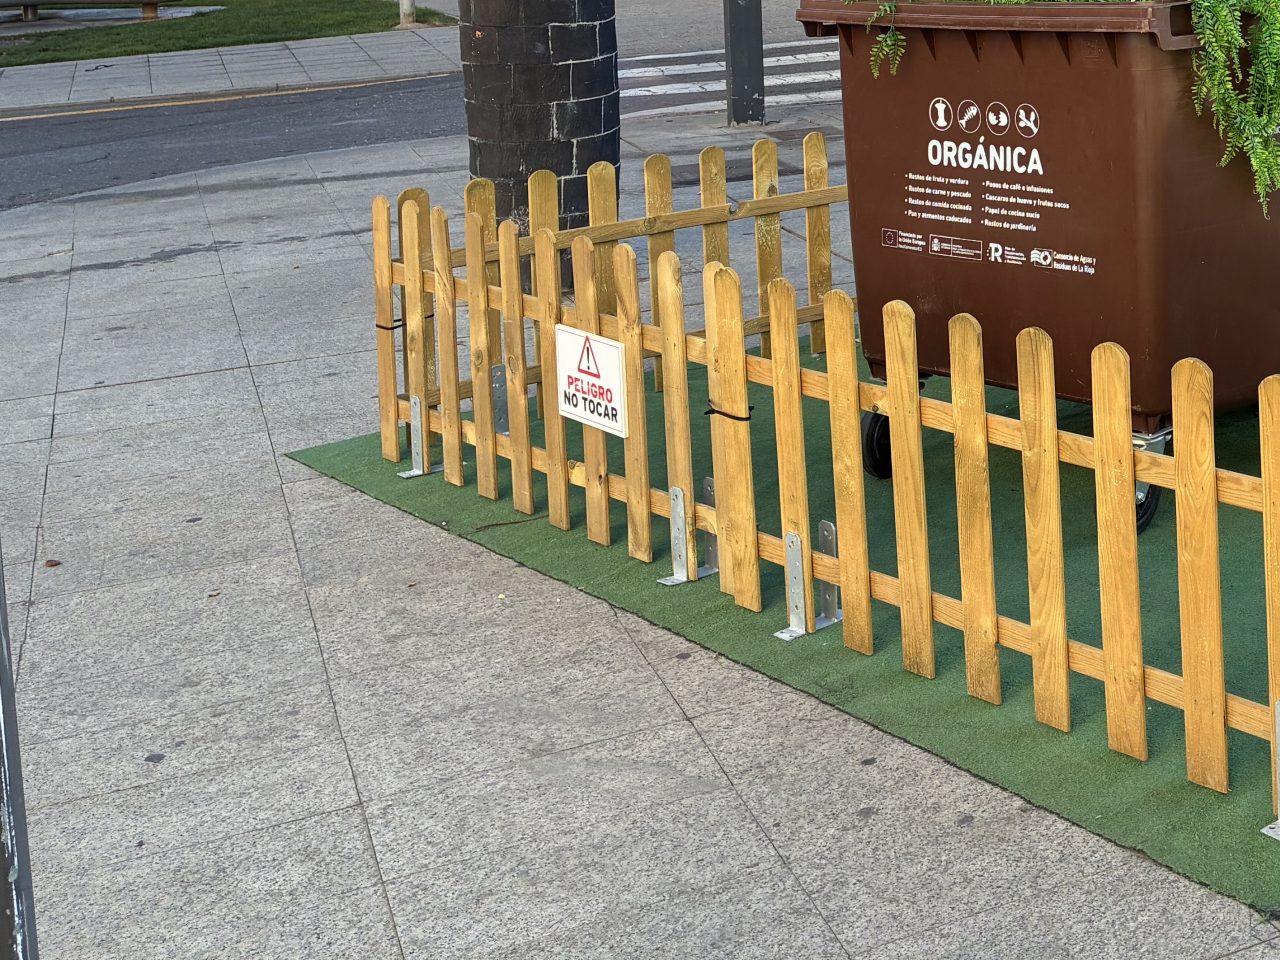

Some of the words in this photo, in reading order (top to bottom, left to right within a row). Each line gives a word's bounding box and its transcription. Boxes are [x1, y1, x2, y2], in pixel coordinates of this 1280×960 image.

[927, 135, 1044, 176] ORGÁNICA
[568, 374, 613, 404] PELIGRO
[564, 390, 578, 408] NO
[582, 396, 618, 423] TOCAR
